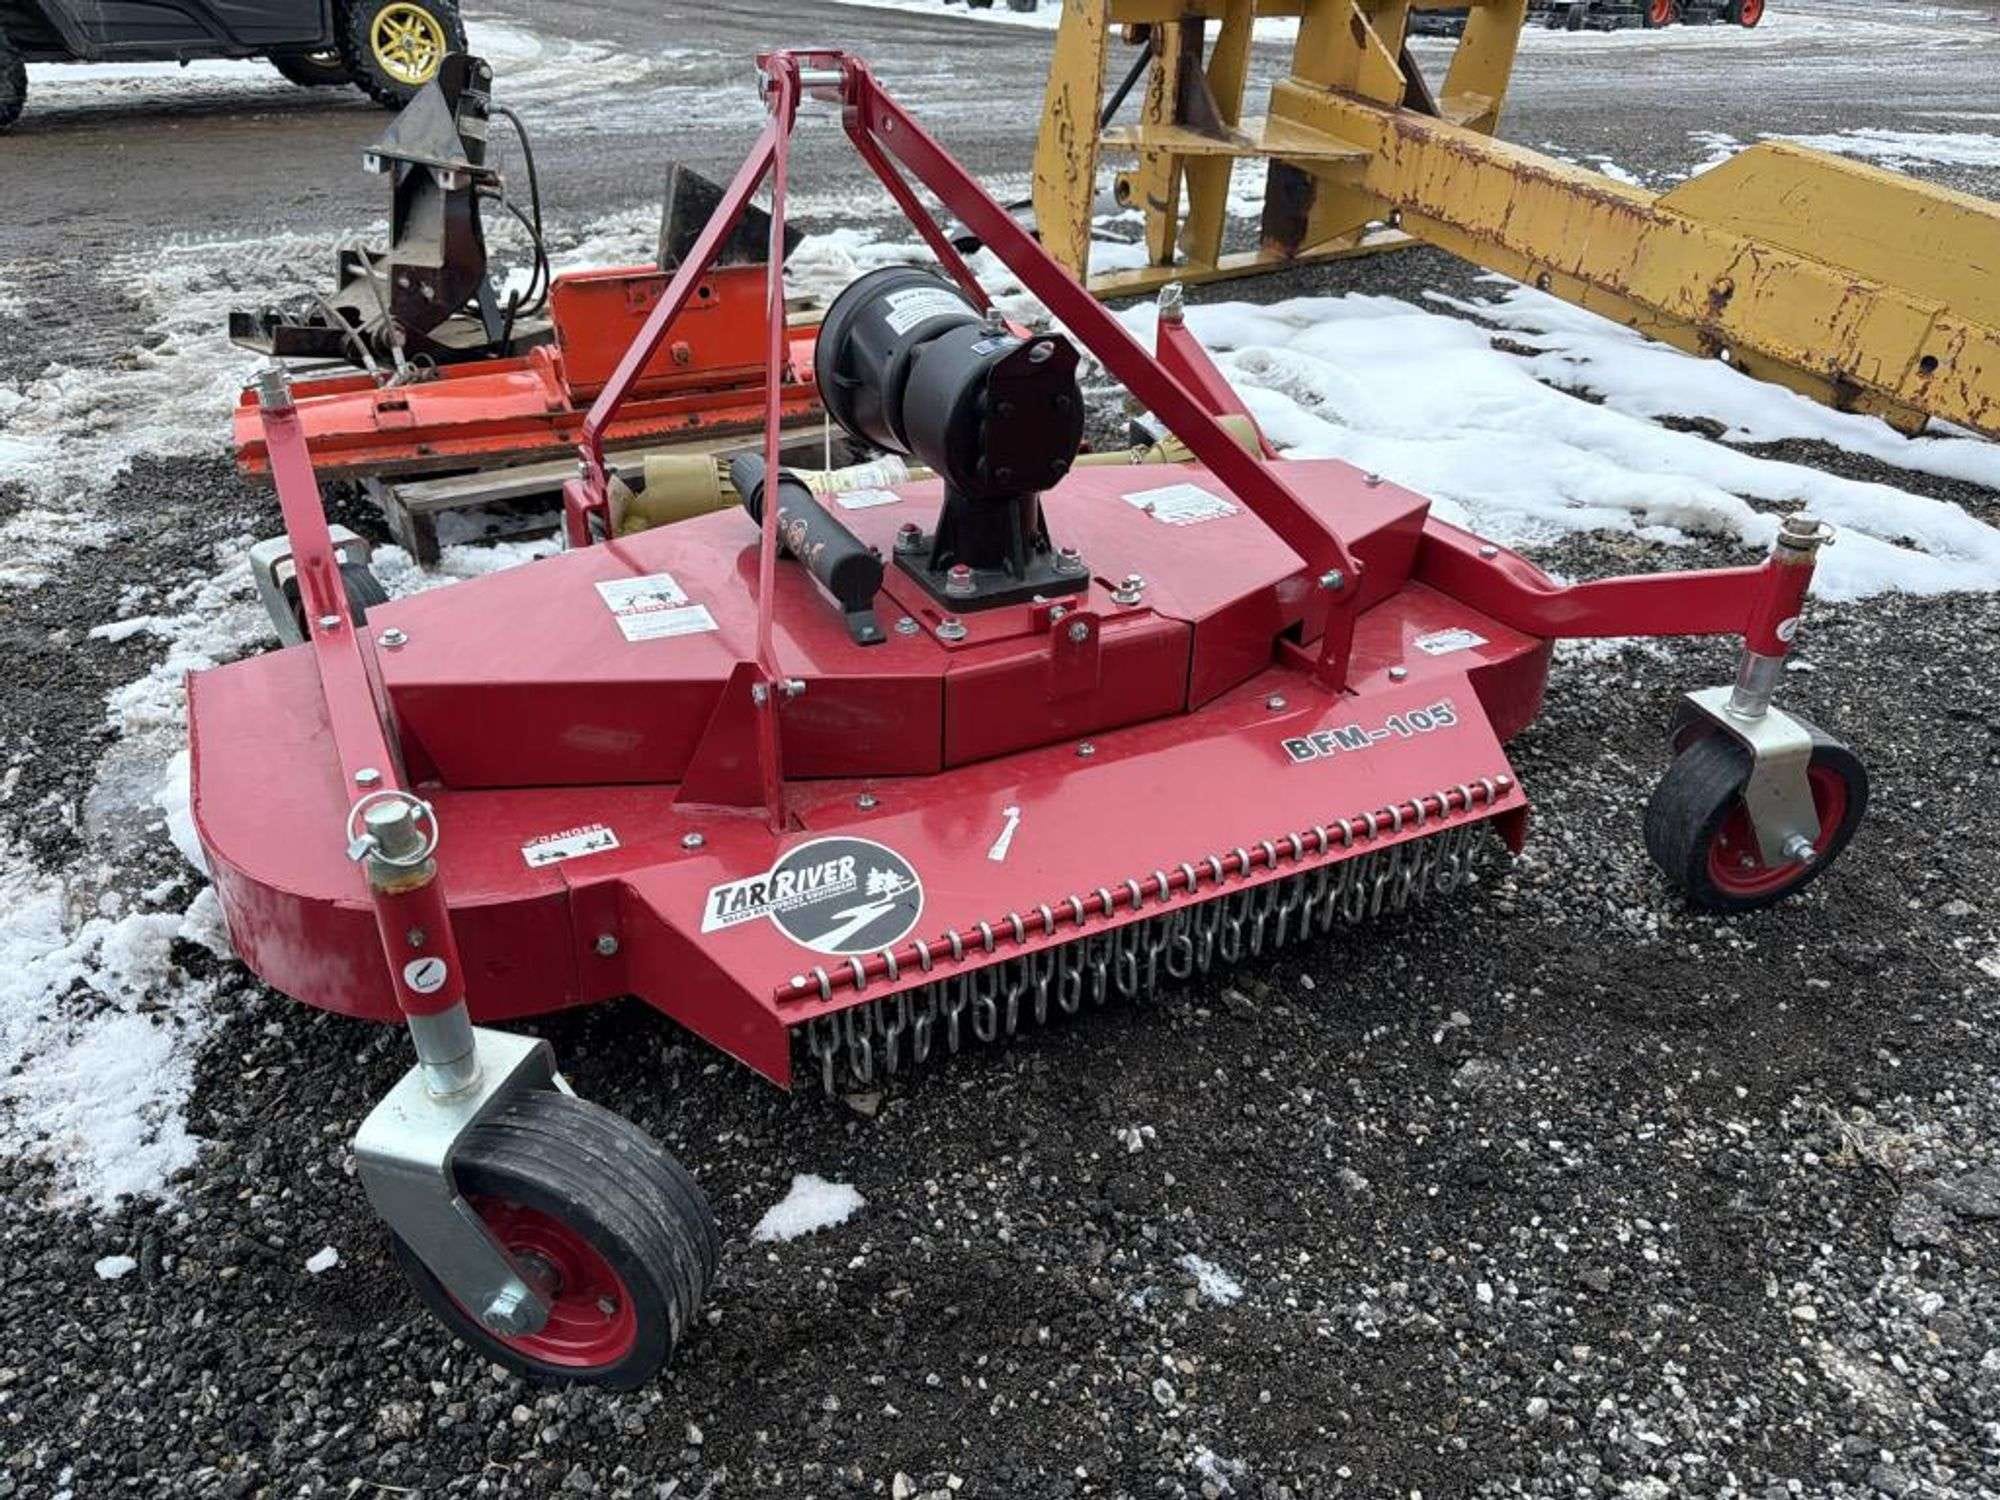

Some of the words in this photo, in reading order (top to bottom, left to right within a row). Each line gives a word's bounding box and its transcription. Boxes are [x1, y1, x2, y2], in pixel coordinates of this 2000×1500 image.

[1283, 703, 1456, 762] BFM-105
[714, 884, 767, 916] TAR
[775, 855, 856, 899] RIVER
